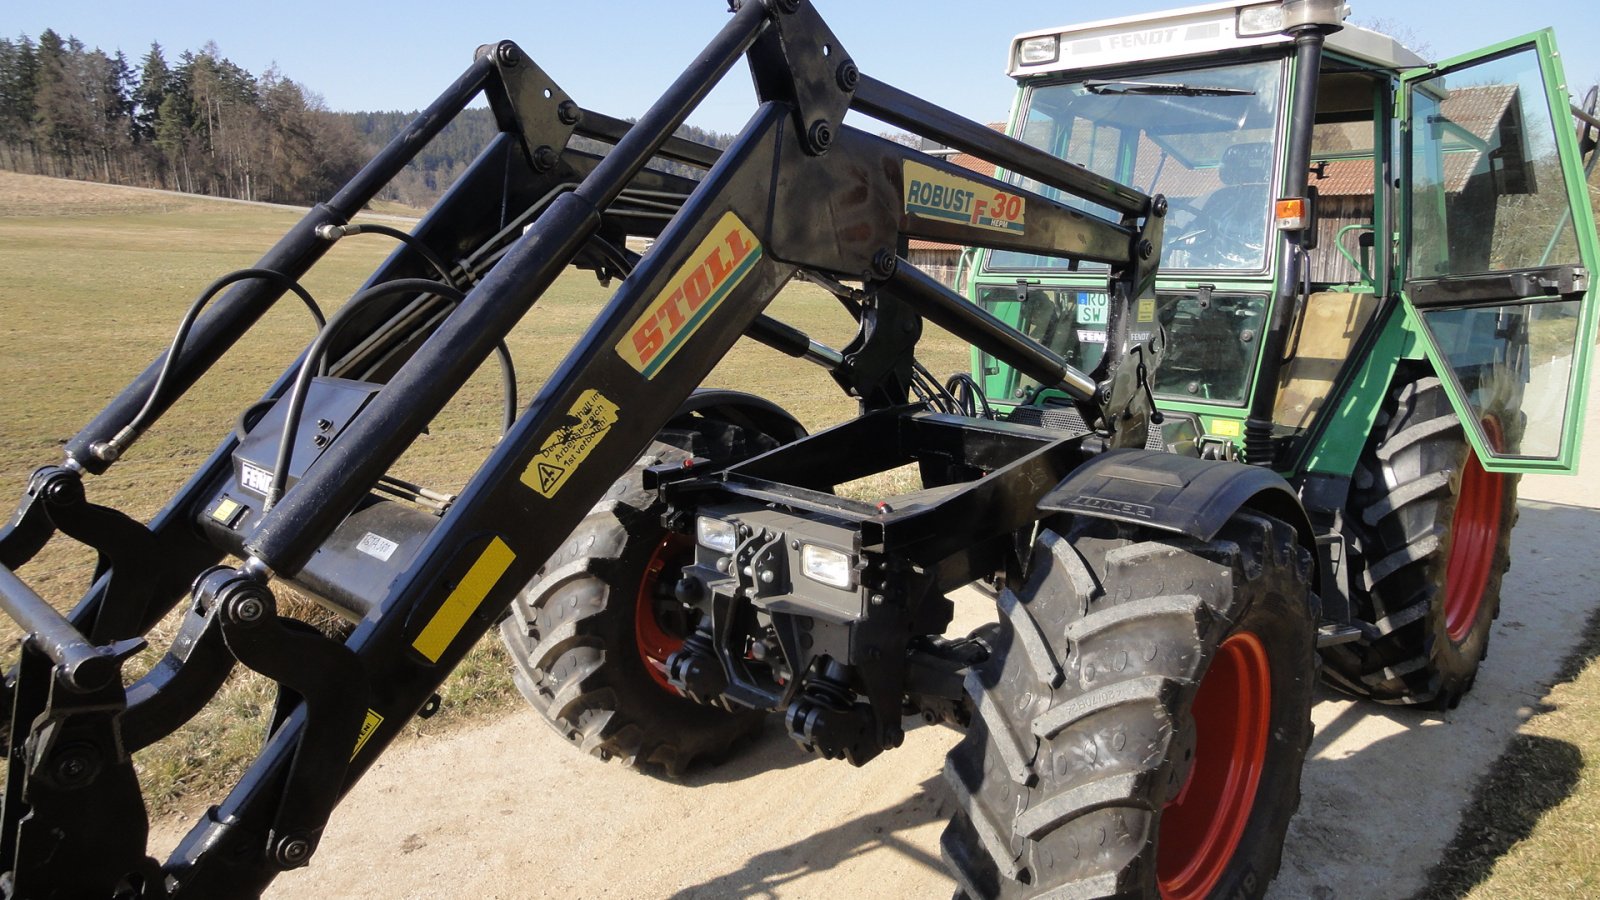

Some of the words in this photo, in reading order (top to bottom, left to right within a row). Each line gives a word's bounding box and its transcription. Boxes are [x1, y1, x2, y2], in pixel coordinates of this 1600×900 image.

[1107, 28, 1179, 50] FENDT
[908, 180, 974, 213] ROBUST
[632, 229, 752, 366] STOLL
[1083, 307, 1101, 321] SW
[1130, 332, 1150, 341] FENDT
